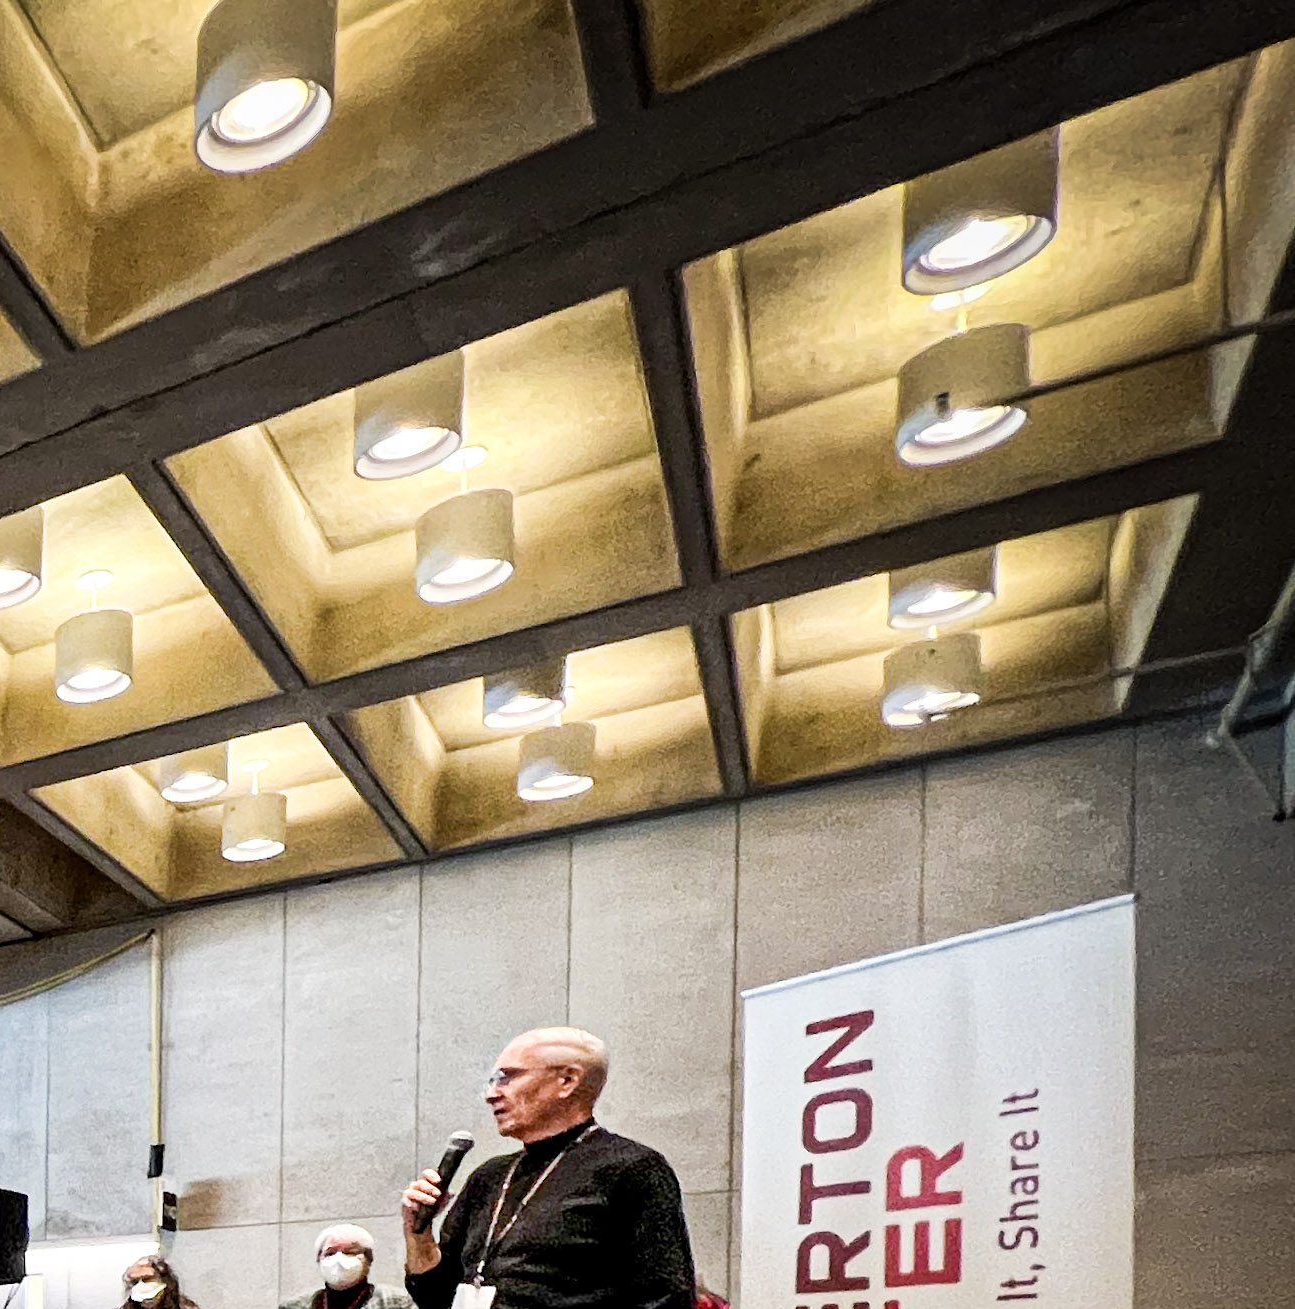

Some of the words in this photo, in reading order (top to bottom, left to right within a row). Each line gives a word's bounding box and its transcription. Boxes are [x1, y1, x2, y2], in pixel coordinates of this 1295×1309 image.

[999, 1088, 1040, 1117] It
[998, 1129, 1040, 1250] Share
[997, 1263, 1046, 1301] It,
